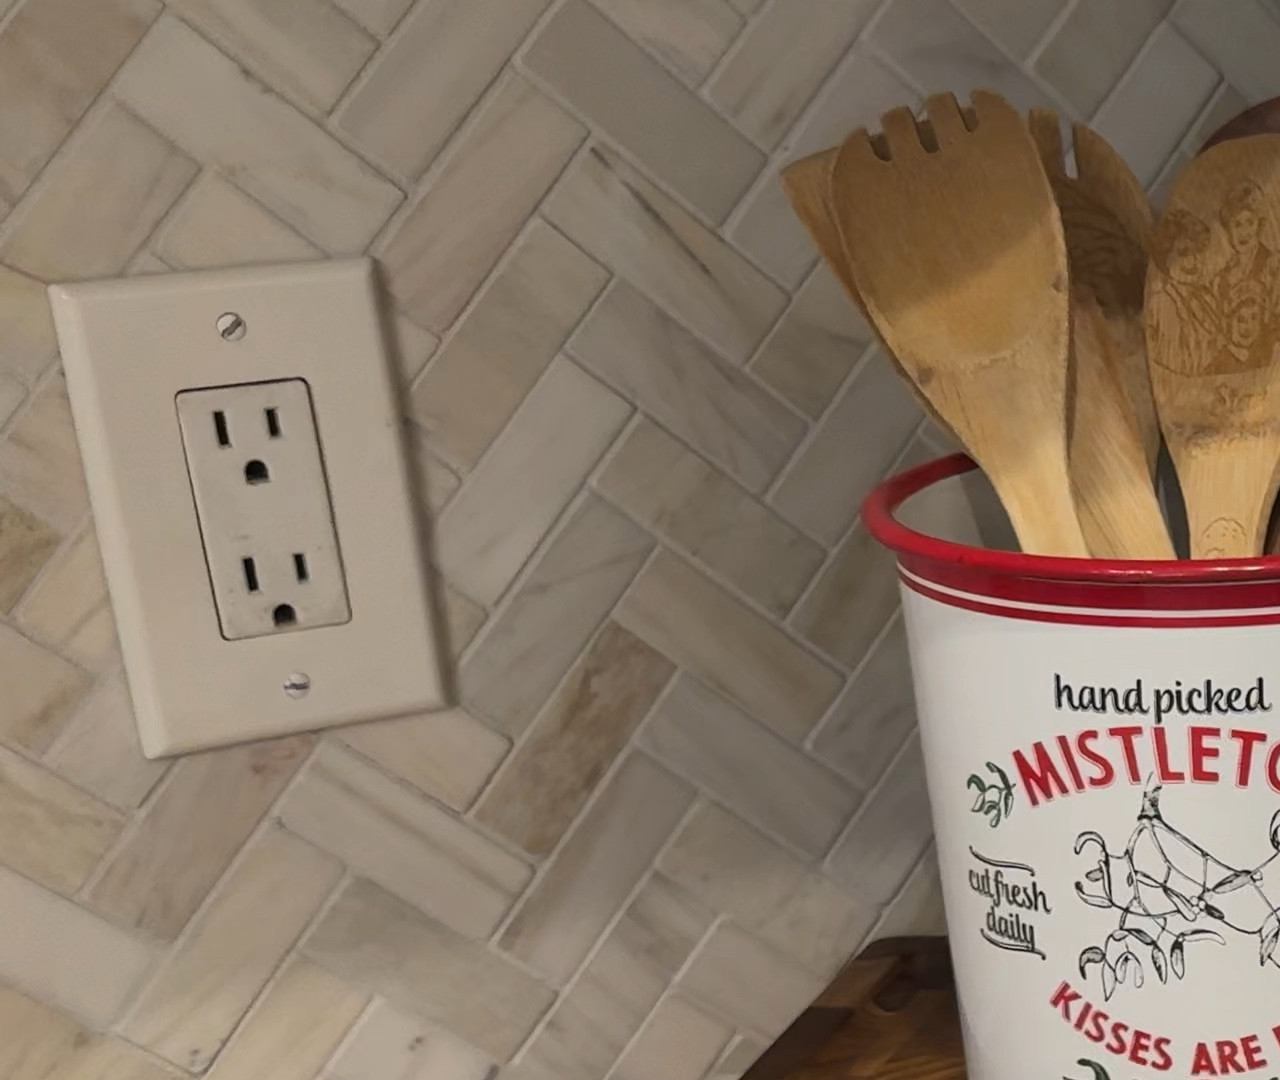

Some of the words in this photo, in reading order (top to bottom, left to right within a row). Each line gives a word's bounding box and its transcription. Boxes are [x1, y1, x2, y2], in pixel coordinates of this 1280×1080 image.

[1054, 673, 1149, 714] hand
[1154, 677, 1272, 724] picked
[969, 869, 994, 898] cut
[994, 870, 1050, 914] fresh
[986, 906, 1035, 951] daily
[1050, 980, 1173, 1071] KISSES
[1191, 1034, 1268, 1076] ARE
